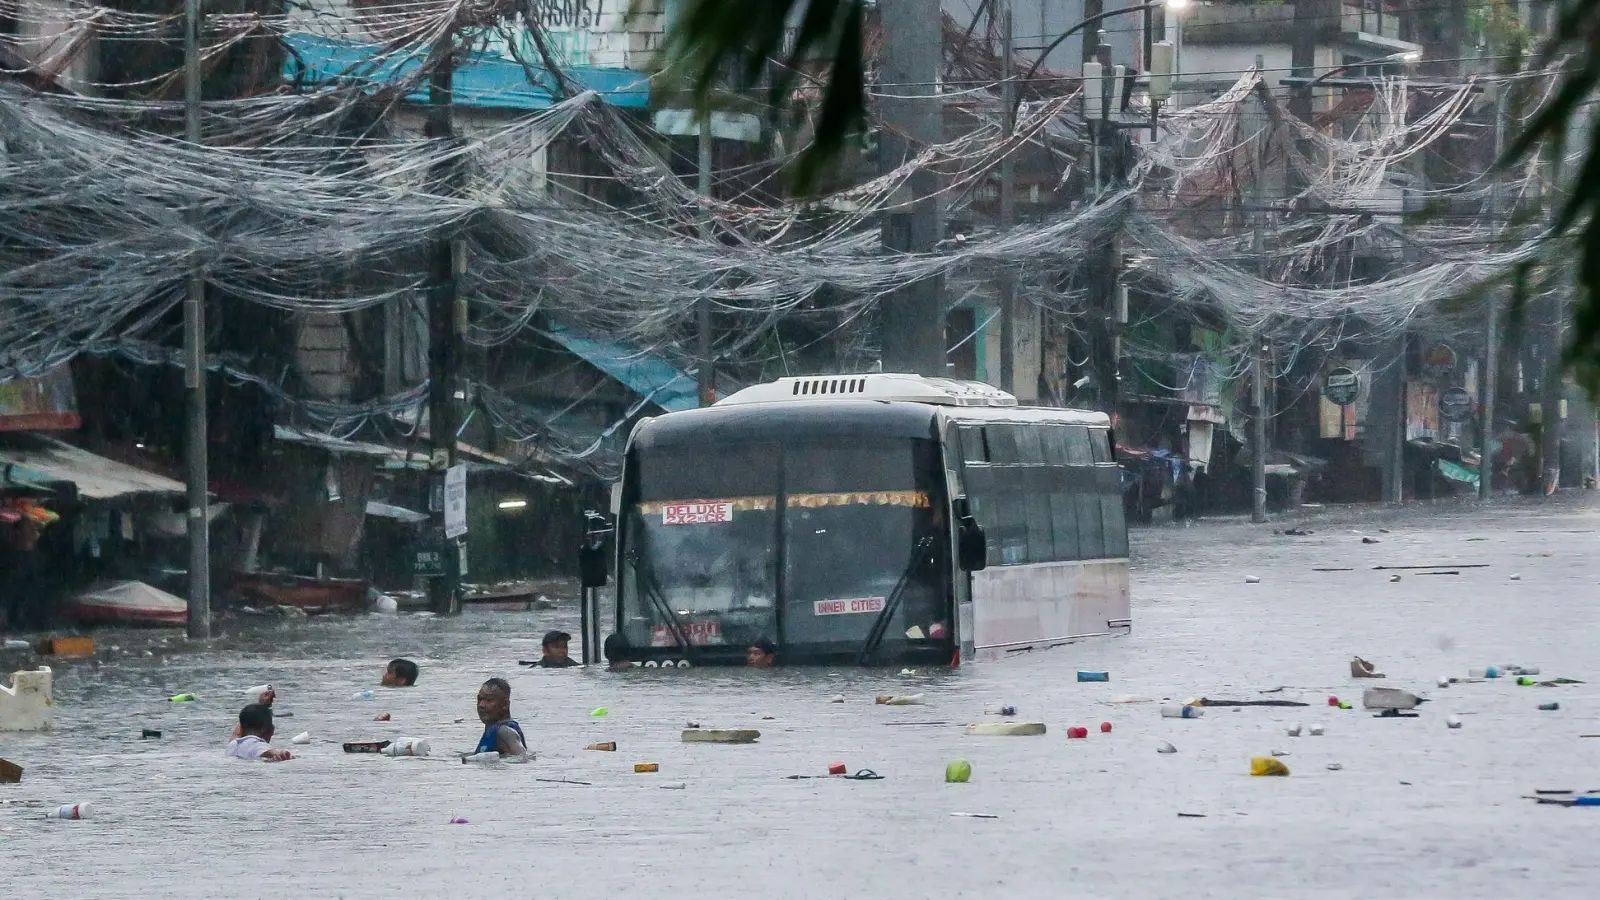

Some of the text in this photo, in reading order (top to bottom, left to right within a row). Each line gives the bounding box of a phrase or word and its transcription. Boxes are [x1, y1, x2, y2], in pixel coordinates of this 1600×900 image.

[666, 503, 727, 516] DELUXE
[818, 599, 882, 613] INNER CITIES
